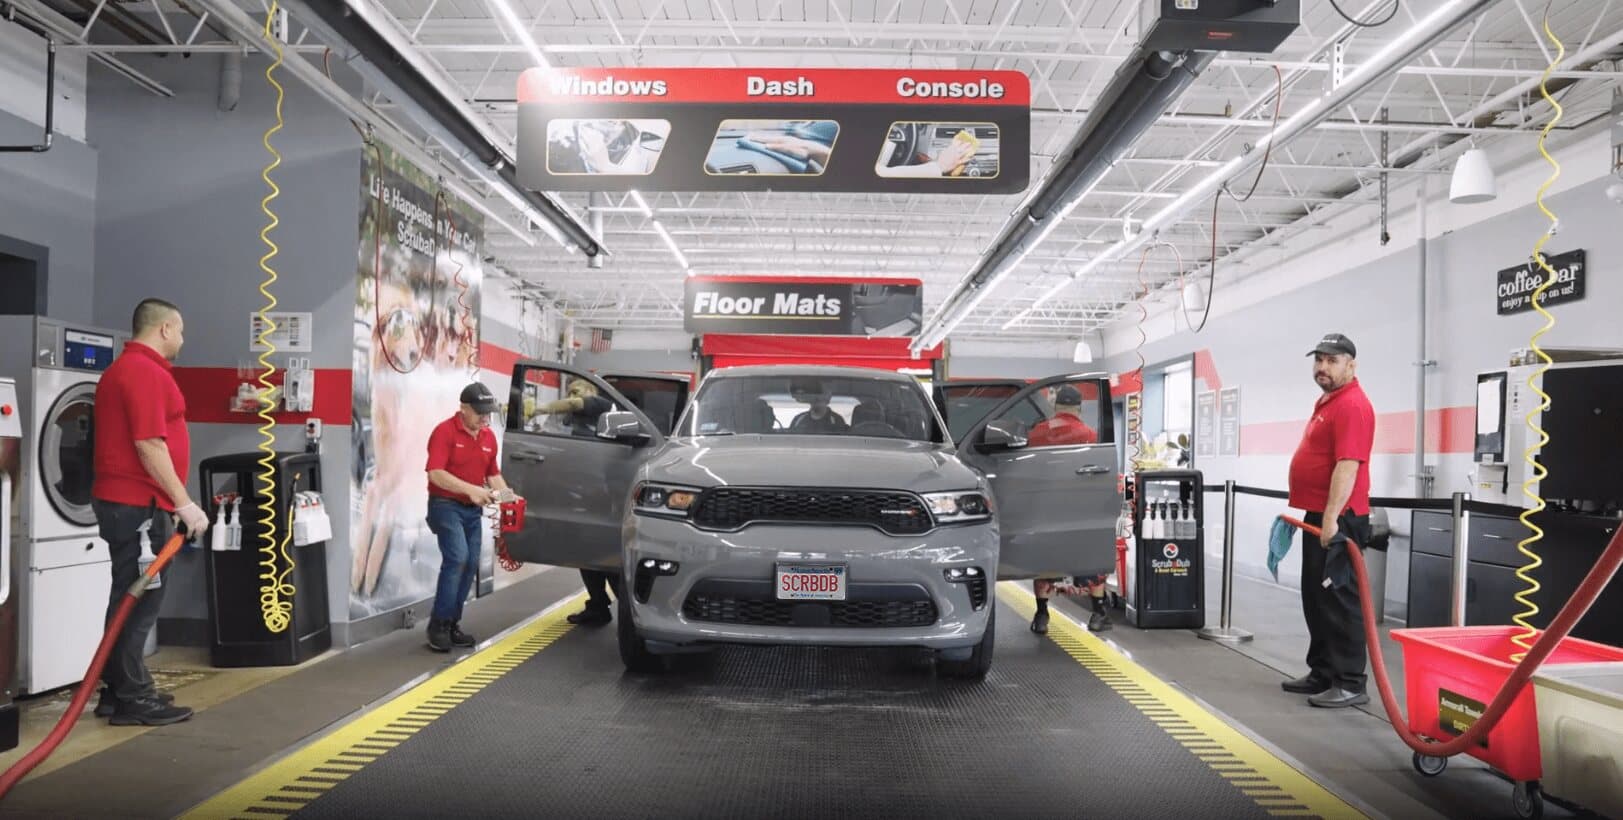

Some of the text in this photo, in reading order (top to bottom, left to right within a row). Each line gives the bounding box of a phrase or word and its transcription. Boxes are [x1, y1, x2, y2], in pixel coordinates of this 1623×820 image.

[550, 76, 668, 97] Windows
[747, 77, 815, 97] Dash
[896, 77, 1005, 99] Console
[369, 173, 390, 204] Lie
[393, 188, 432, 228] Happens
[463, 232, 476, 254] Car
[397, 221, 444, 258] ScrubaD
[1499, 270, 1542, 297] coffee
[1502, 296, 1522, 308] enjoy
[1532, 291, 1547, 303] up
[1549, 290, 1559, 298] on
[1561, 281, 1573, 294] us!
[693, 291, 841, 316] Floor Mats
[782, 575, 838, 591] SCRBDB
